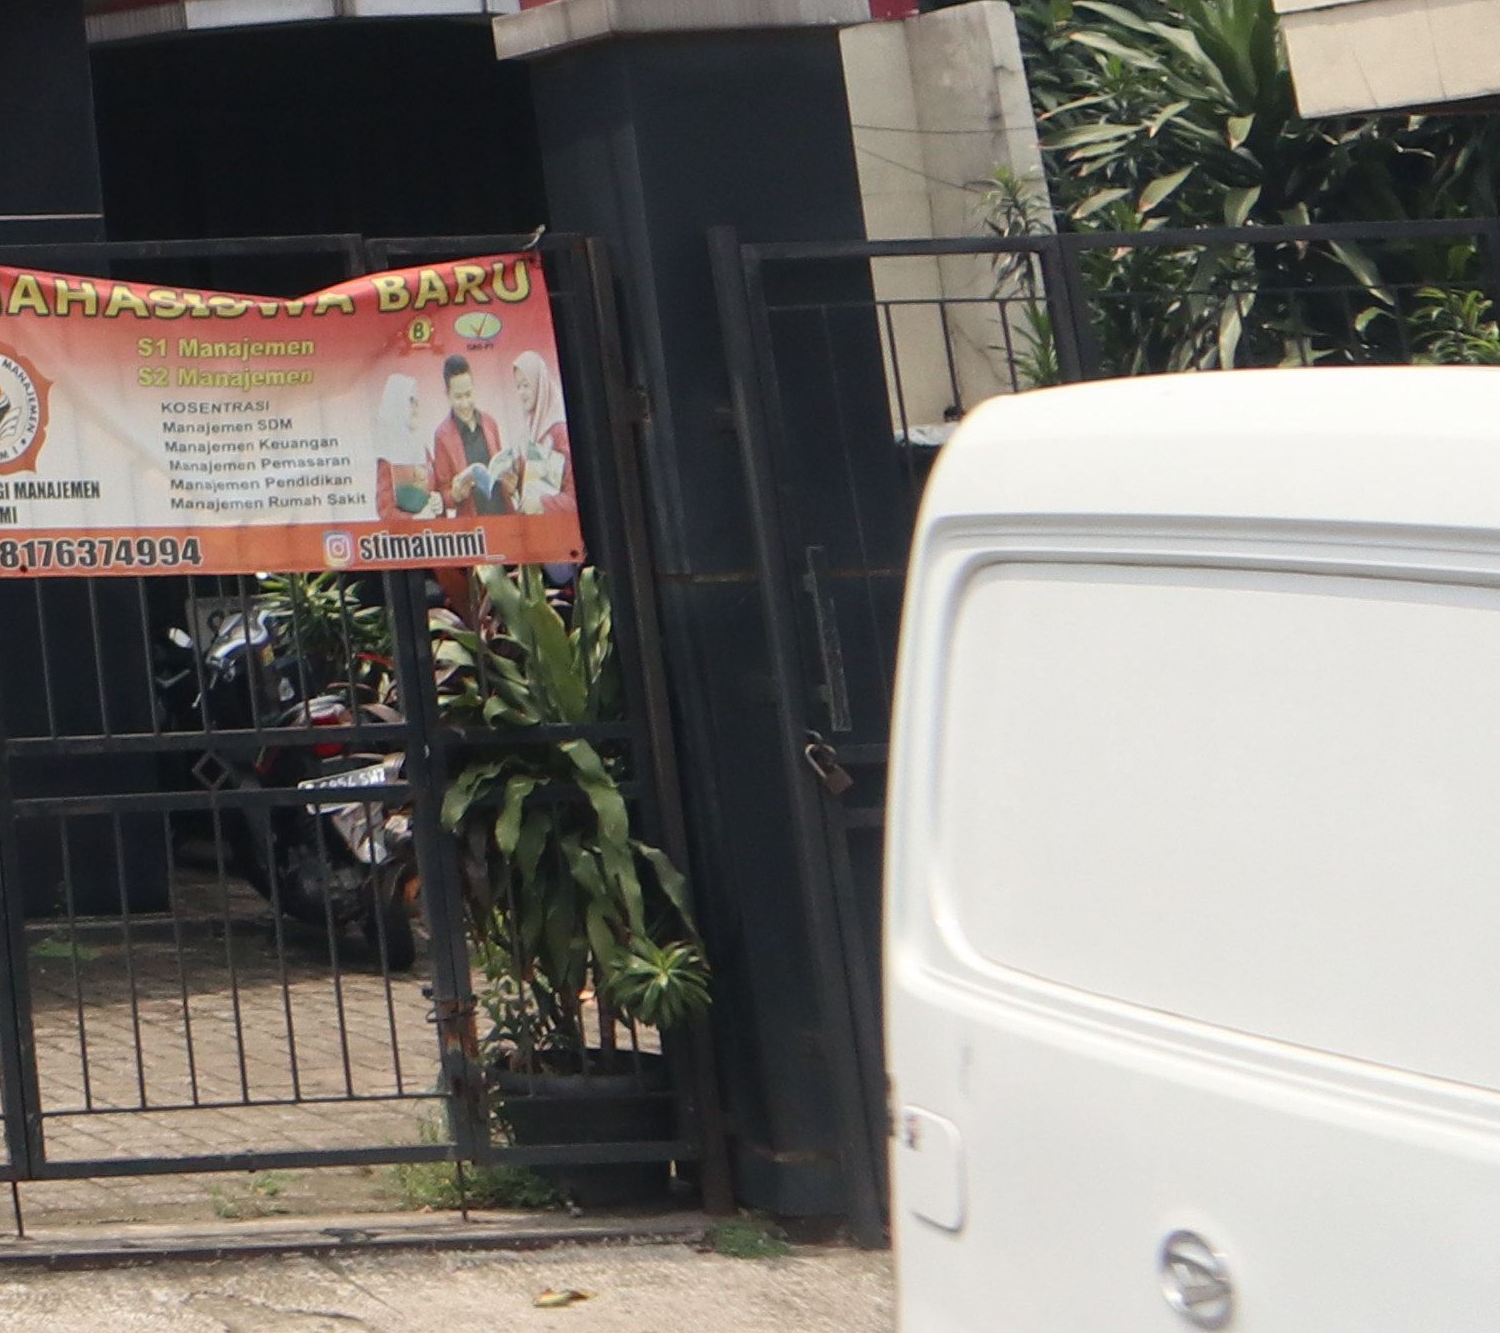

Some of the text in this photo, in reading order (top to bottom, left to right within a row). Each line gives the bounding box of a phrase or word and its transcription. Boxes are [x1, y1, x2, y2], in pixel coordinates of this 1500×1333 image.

[370, 258, 535, 315] BARU
[137, 337, 316, 362] S1 Manajemen
[137, 366, 315, 393] S2 Manajemen
[0, 358, 39, 434] MANAJEMEN
[160, 400, 271, 415] KOSENTRASI
[162, 418, 294, 437] Manajemen SDM
[164, 436, 340, 456] Manajemen Keuangan
[169, 455, 352, 475] Manajemen Pemasaran
[13, 480, 101, 501] MANAJEMEN
[169, 474, 354, 494] Manajemen Pendidikan
[169, 492, 368, 513] Manajemen Rumah Sakit
